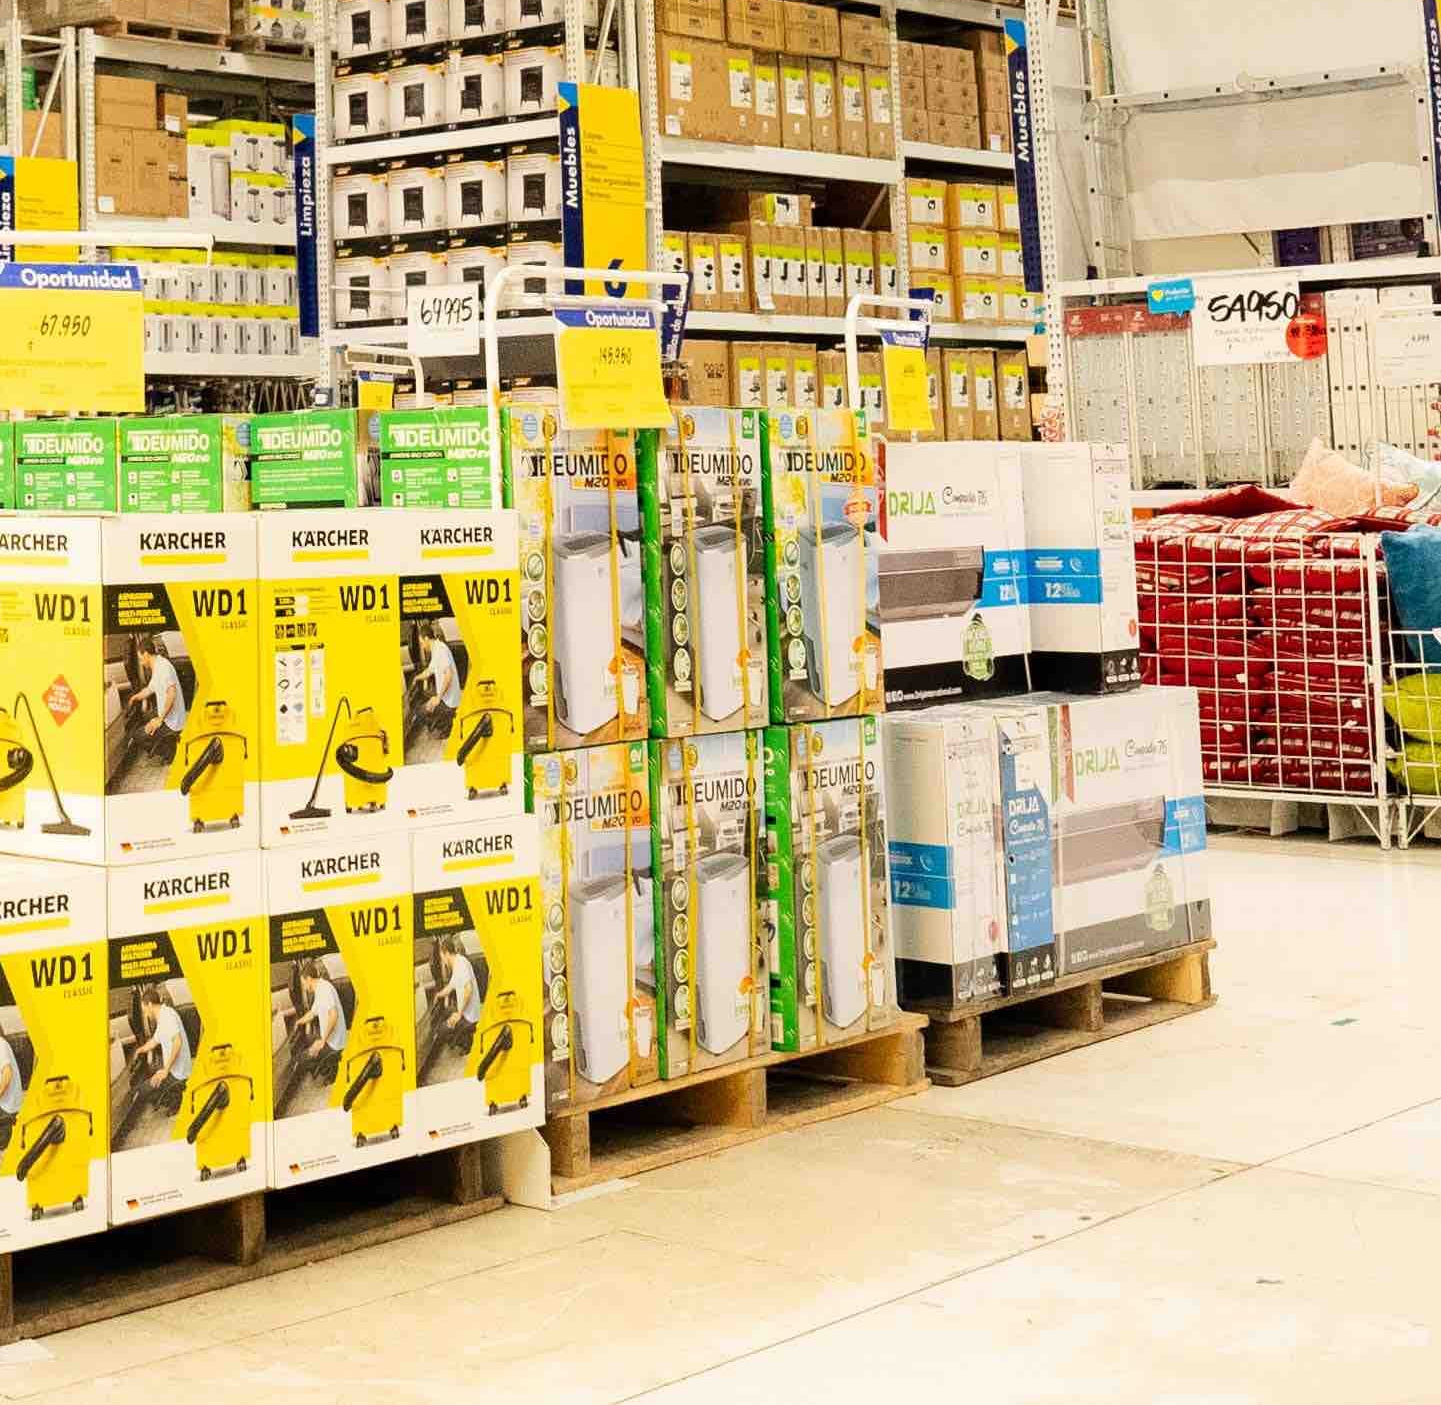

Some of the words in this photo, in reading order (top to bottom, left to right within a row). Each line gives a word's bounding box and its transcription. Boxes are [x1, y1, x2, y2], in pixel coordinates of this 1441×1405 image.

[219, 56, 227, 66] A
[1014, 70, 1030, 162] Muebles
[564, 127, 579, 209] Muebles
[299, 157, 314, 237] Limpieza
[20, 270, 133, 289] Oportunidad
[604, 259, 627, 298] 6
[585, 310, 650, 328] Oportunidad
[1208, 290, 1298, 322] 54950
[40, 314, 91, 337] 67.950
[889, 490, 936, 516] DRIJA
[140, 531, 227, 551] KÄRCHER
[292, 528, 370, 549] KÄRCHER
[420, 525, 494, 545] KÄRCHER
[192, 588, 248, 618] WD1
[339, 583, 391, 612] WD1
[465, 578, 513, 606] WD1
[34, 593, 91, 624] WD1
[1008, 795, 1040, 816] DRIJA
[442, 834, 514, 859] KÄRCHER
[301, 852, 381, 879] KÄRCHER
[143, 872, 231, 900] KÄRCHER
[485, 884, 534, 916] WD1
[350, 906, 403, 938] WD1
[196, 929, 254, 962] WD1
[30, 952, 94, 990] WD1
